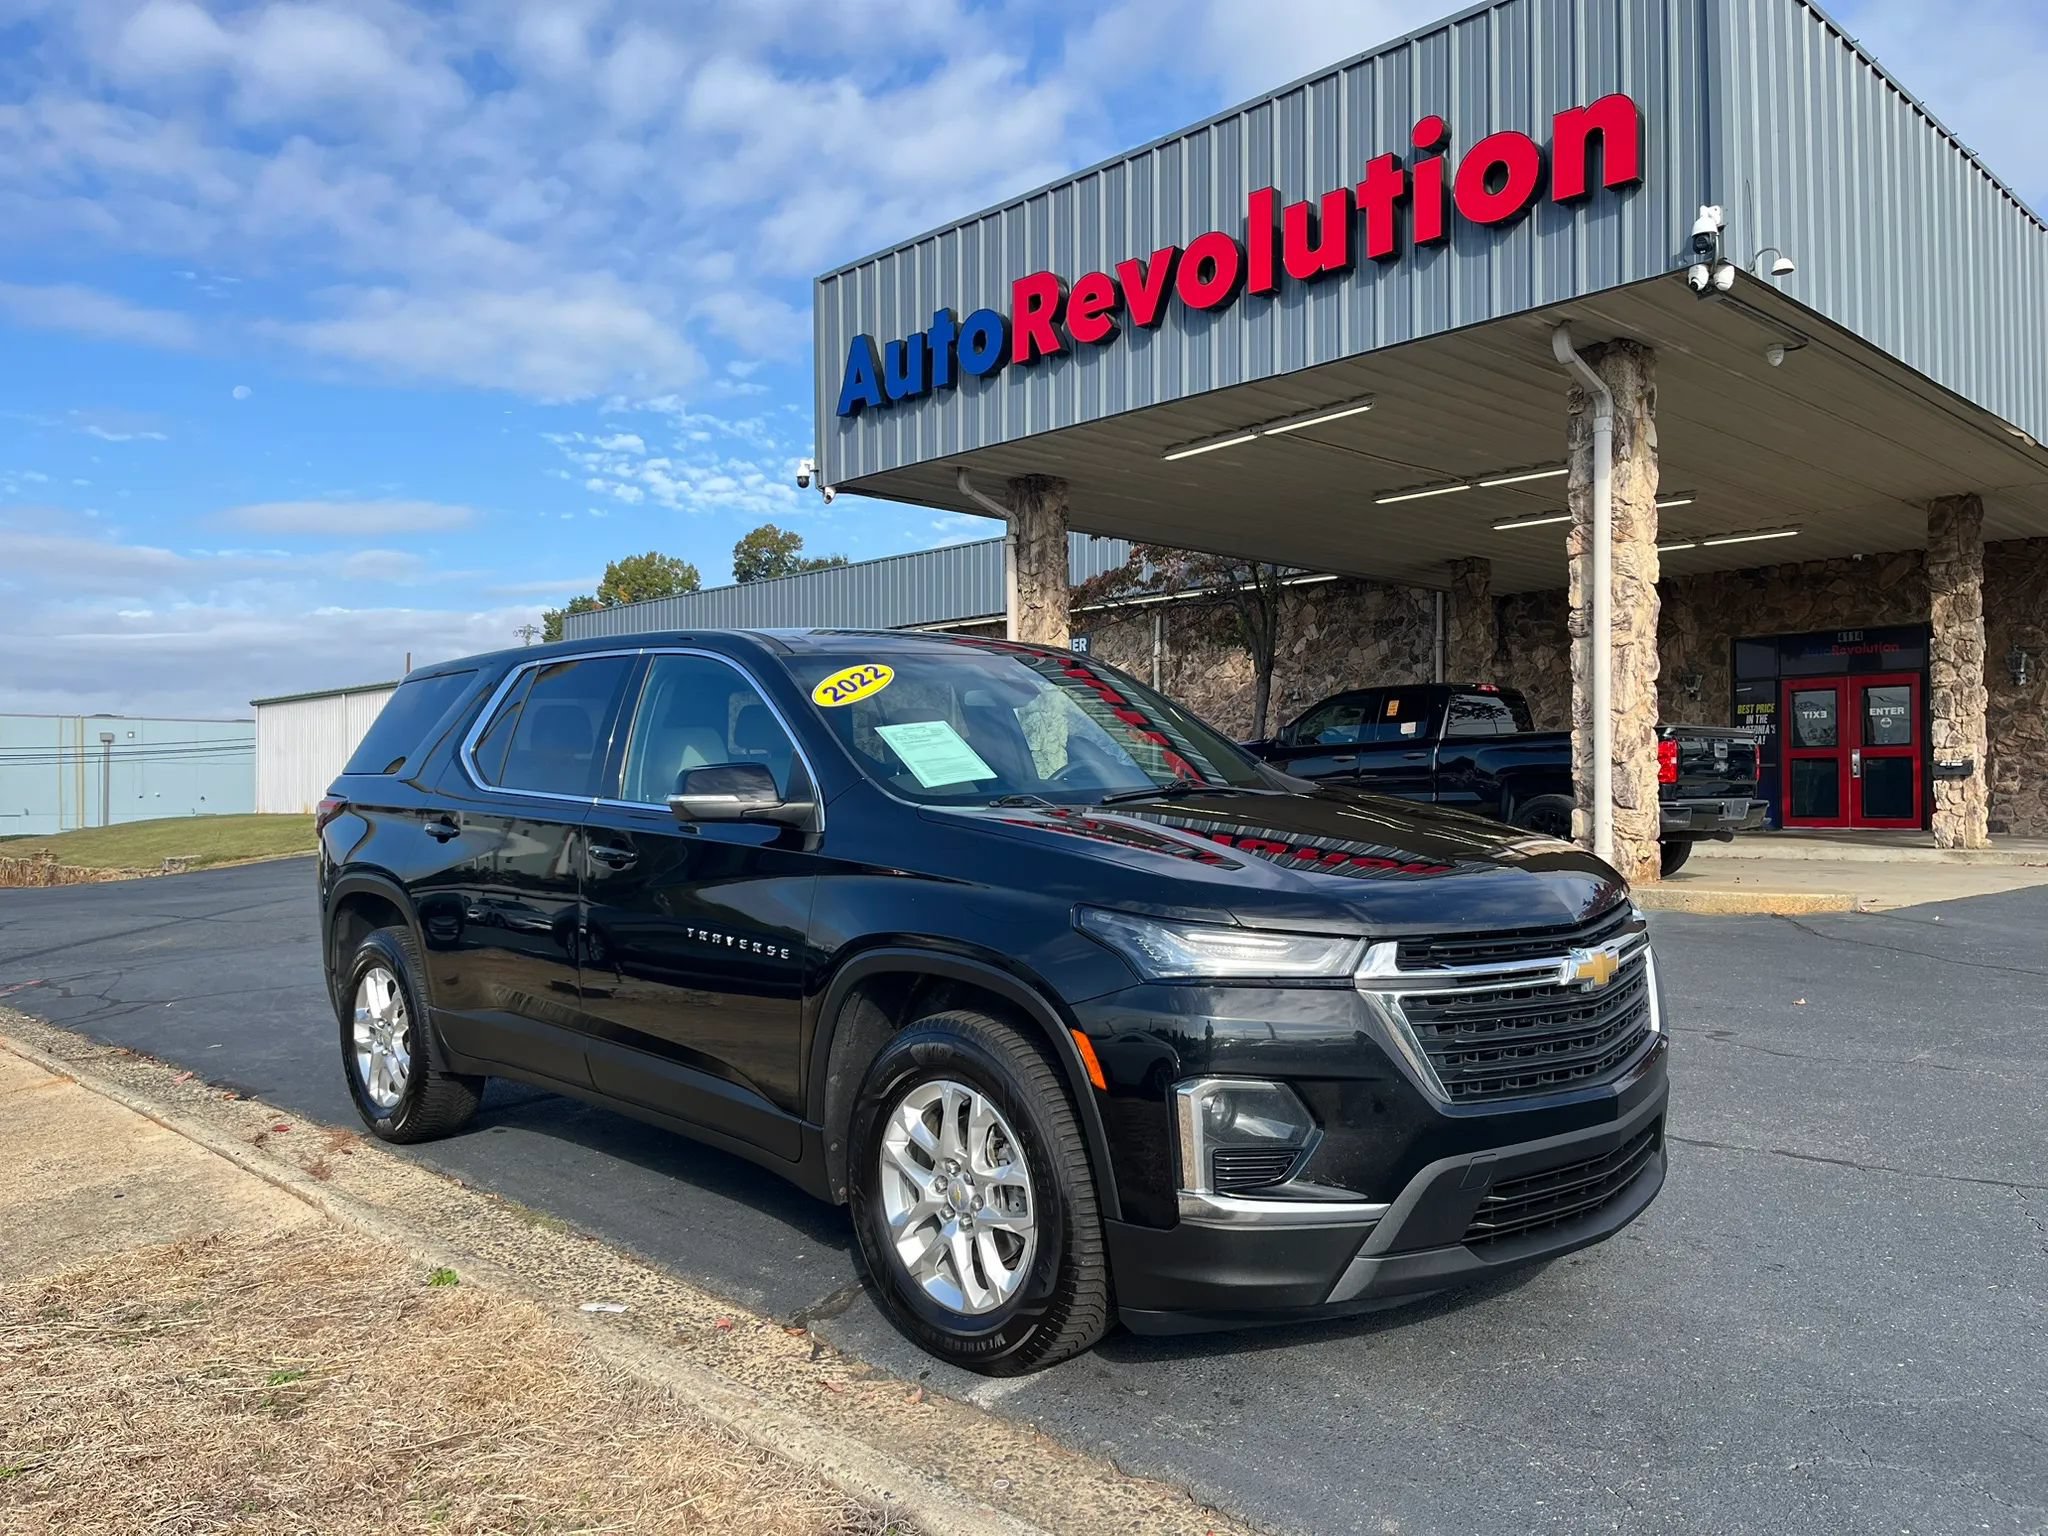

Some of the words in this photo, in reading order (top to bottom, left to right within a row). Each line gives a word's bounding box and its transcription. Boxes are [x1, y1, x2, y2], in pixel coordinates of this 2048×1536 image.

[1069, 637, 1087, 652] ER
[822, 666, 886, 702] 2022
[1737, 704, 1755, 714] BEST
[1756, 703, 1775, 713] PRICE
[1869, 706, 1905, 716] ENTER
[1755, 714, 1768, 724] THE
[1736, 724, 1776, 735] ONIA'S
[686, 927, 790, 960] TRAVERSE
